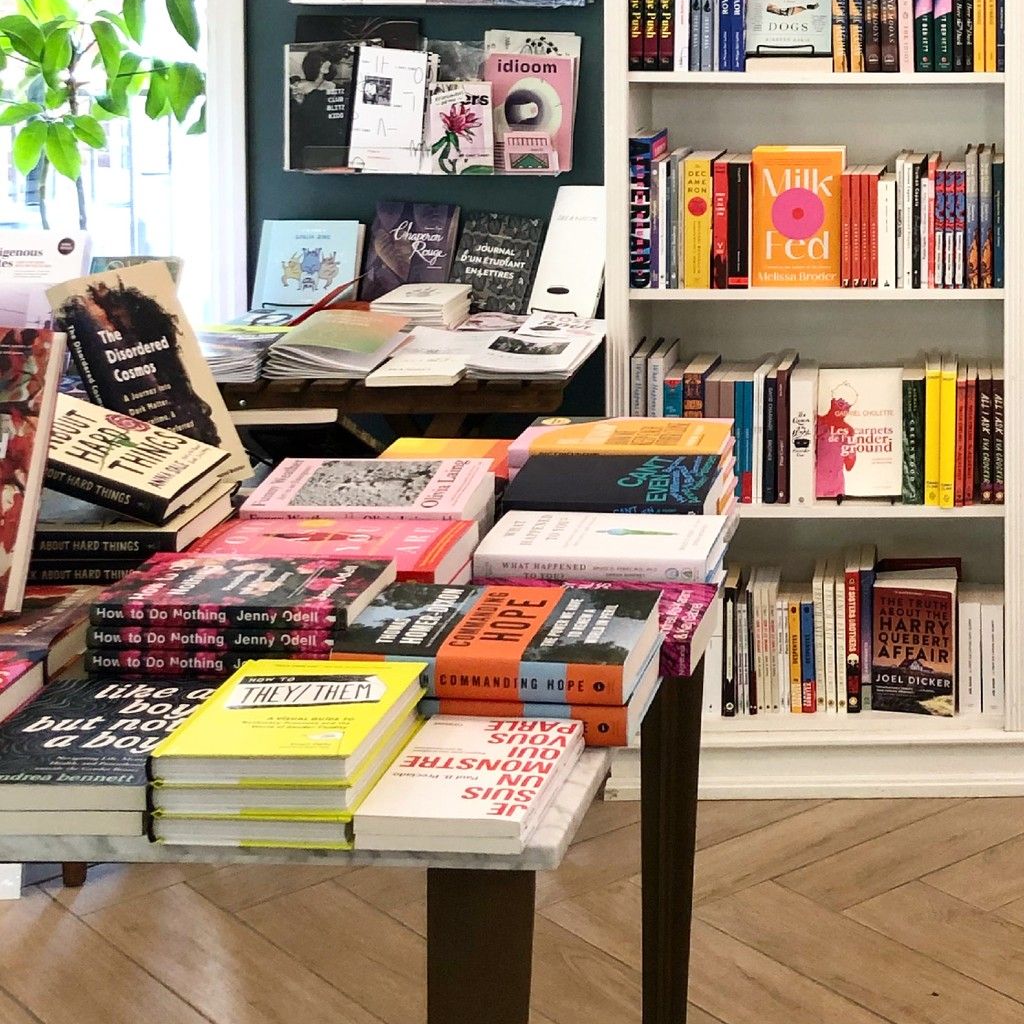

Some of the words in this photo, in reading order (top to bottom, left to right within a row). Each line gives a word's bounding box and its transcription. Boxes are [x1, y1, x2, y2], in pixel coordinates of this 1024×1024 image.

[768, 22, 809, 31] DOGS
[497, 59, 558, 74] idioom
[762, 168, 834, 197] Milk
[391, 220, 444, 242] Chaperon
[411, 240, 447, 265] Rouge
[475, 244, 516, 256] JOURNAL
[765, 230, 829, 260] Fed
[465, 267, 477, 276] EN
[478, 267, 515, 280] LETTRES
[758, 272, 798, 281] Melissa
[800, 271, 838, 281] Broder
[97, 329, 123, 344] The
[105, 336, 170, 365] Disordered
[113, 362, 158, 384] Cosmos
[830, 426, 849, 434] Les
[65, 426, 131, 464] HARD
[841, 442, 892, 456] ground
[108, 432, 191, 475] THINGS
[421, 483, 446, 509] Olivia
[442, 460, 471, 487] Laing
[502, 562, 529, 570] WHAT
[534, 562, 587, 571] HAPPENED
[880, 597, 906, 607] THE
[909, 599, 948, 609] TRUTH
[449, 592, 509, 647] COMMANDING
[479, 598, 547, 643] HOPE
[879, 607, 920, 617] ABOUT
[922, 609, 948, 621] THE
[879, 617, 951, 635] HARRY
[93, 631, 122, 643] How
[128, 632, 142, 644] to
[148, 633, 166, 644] Do
[171, 633, 224, 646] Nothing
[233, 634, 276, 648] Jenny
[280, 635, 316, 647] Odell
[878, 632, 949, 647] QUEBERT
[878, 647, 949, 663] AFFAIR
[439, 674, 538, 689] COMMANDING
[547, 679, 585, 692] HOPE
[875, 674, 904, 683] JOEL
[908, 676, 951, 688] DICKER
[95, 684, 182, 699] like
[188, 688, 213, 700] a
[244, 682, 372, 705] THEY/THEM
[118, 700, 200, 720] boy
[22, 716, 107, 734] but
[112, 715, 189, 732] not
[485, 721, 578, 734] PARLE
[44, 734, 83, 748] a
[86, 731, 165, 754] boy
[488, 734, 567, 747] VOUS
[508, 747, 561, 760] QUI
[399, 756, 553, 774] MONSTRE
[56, 773, 136, 784] bennett
[497, 774, 544, 788] UN
[461, 787, 537, 802] SUIS
[486, 803, 528, 816] JE
